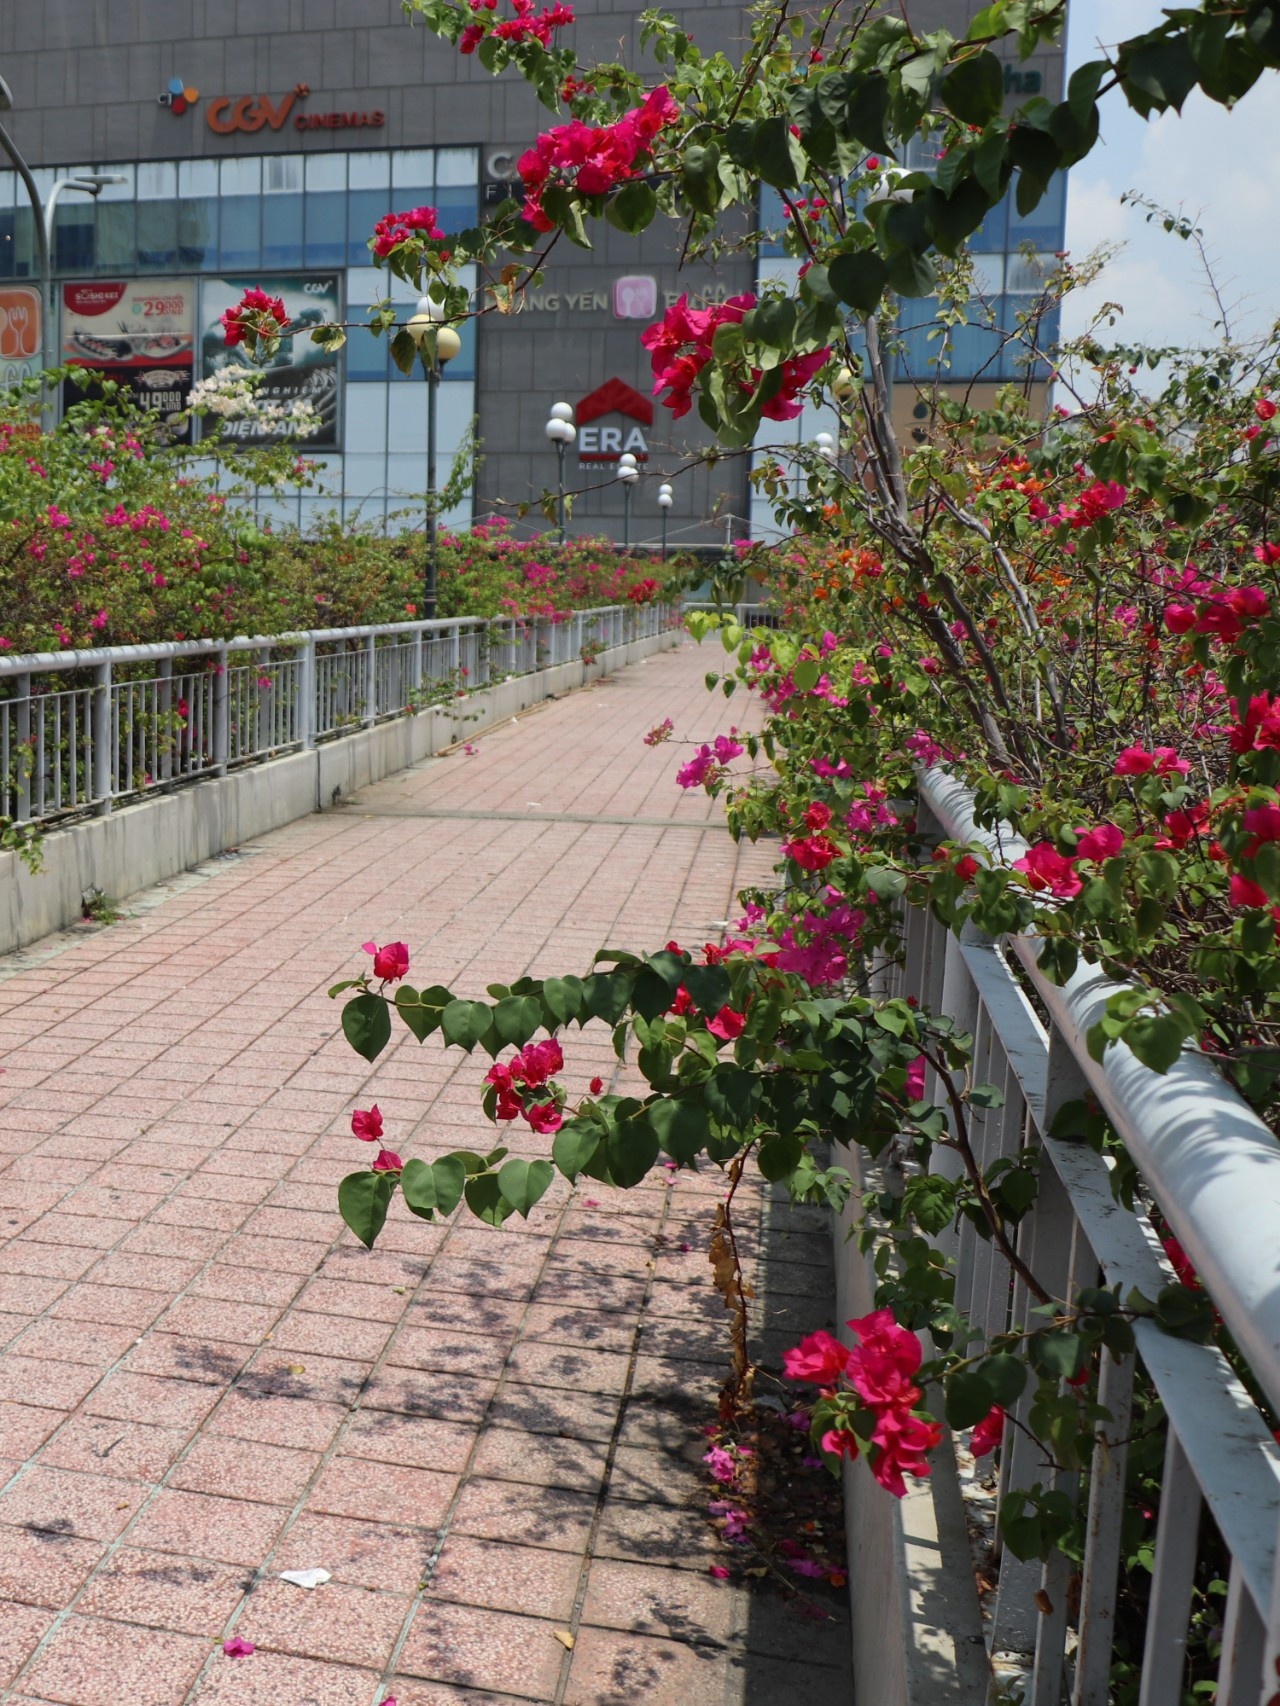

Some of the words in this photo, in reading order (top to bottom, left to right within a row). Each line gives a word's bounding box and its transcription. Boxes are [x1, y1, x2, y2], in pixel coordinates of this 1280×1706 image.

[206, 92, 298, 135] CGV
[293, 110, 385, 132] CINEMAS
[303, 282, 330, 294] CGV
[578, 426, 649, 452] ERA
[579, 462, 606, 470] REAL
[609, 462, 649, 470] ESTE
